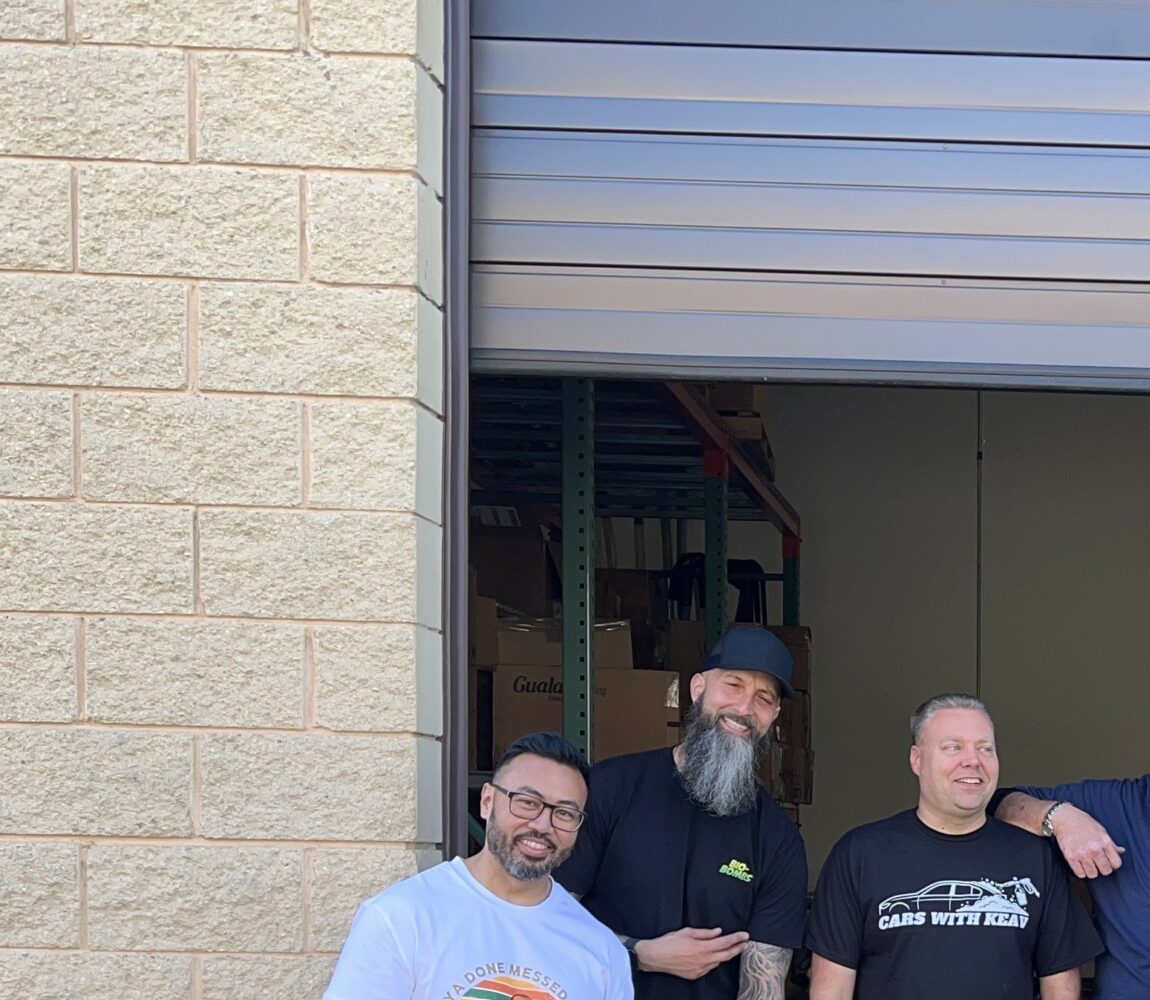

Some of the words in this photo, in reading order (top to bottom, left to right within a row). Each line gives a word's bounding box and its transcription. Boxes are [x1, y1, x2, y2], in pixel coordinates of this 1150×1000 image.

[878, 911, 927, 931] CARS
[931, 911, 982, 926] WITH
[463, 962, 506, 984] DONE
[508, 964, 568, 1000] MESSED
